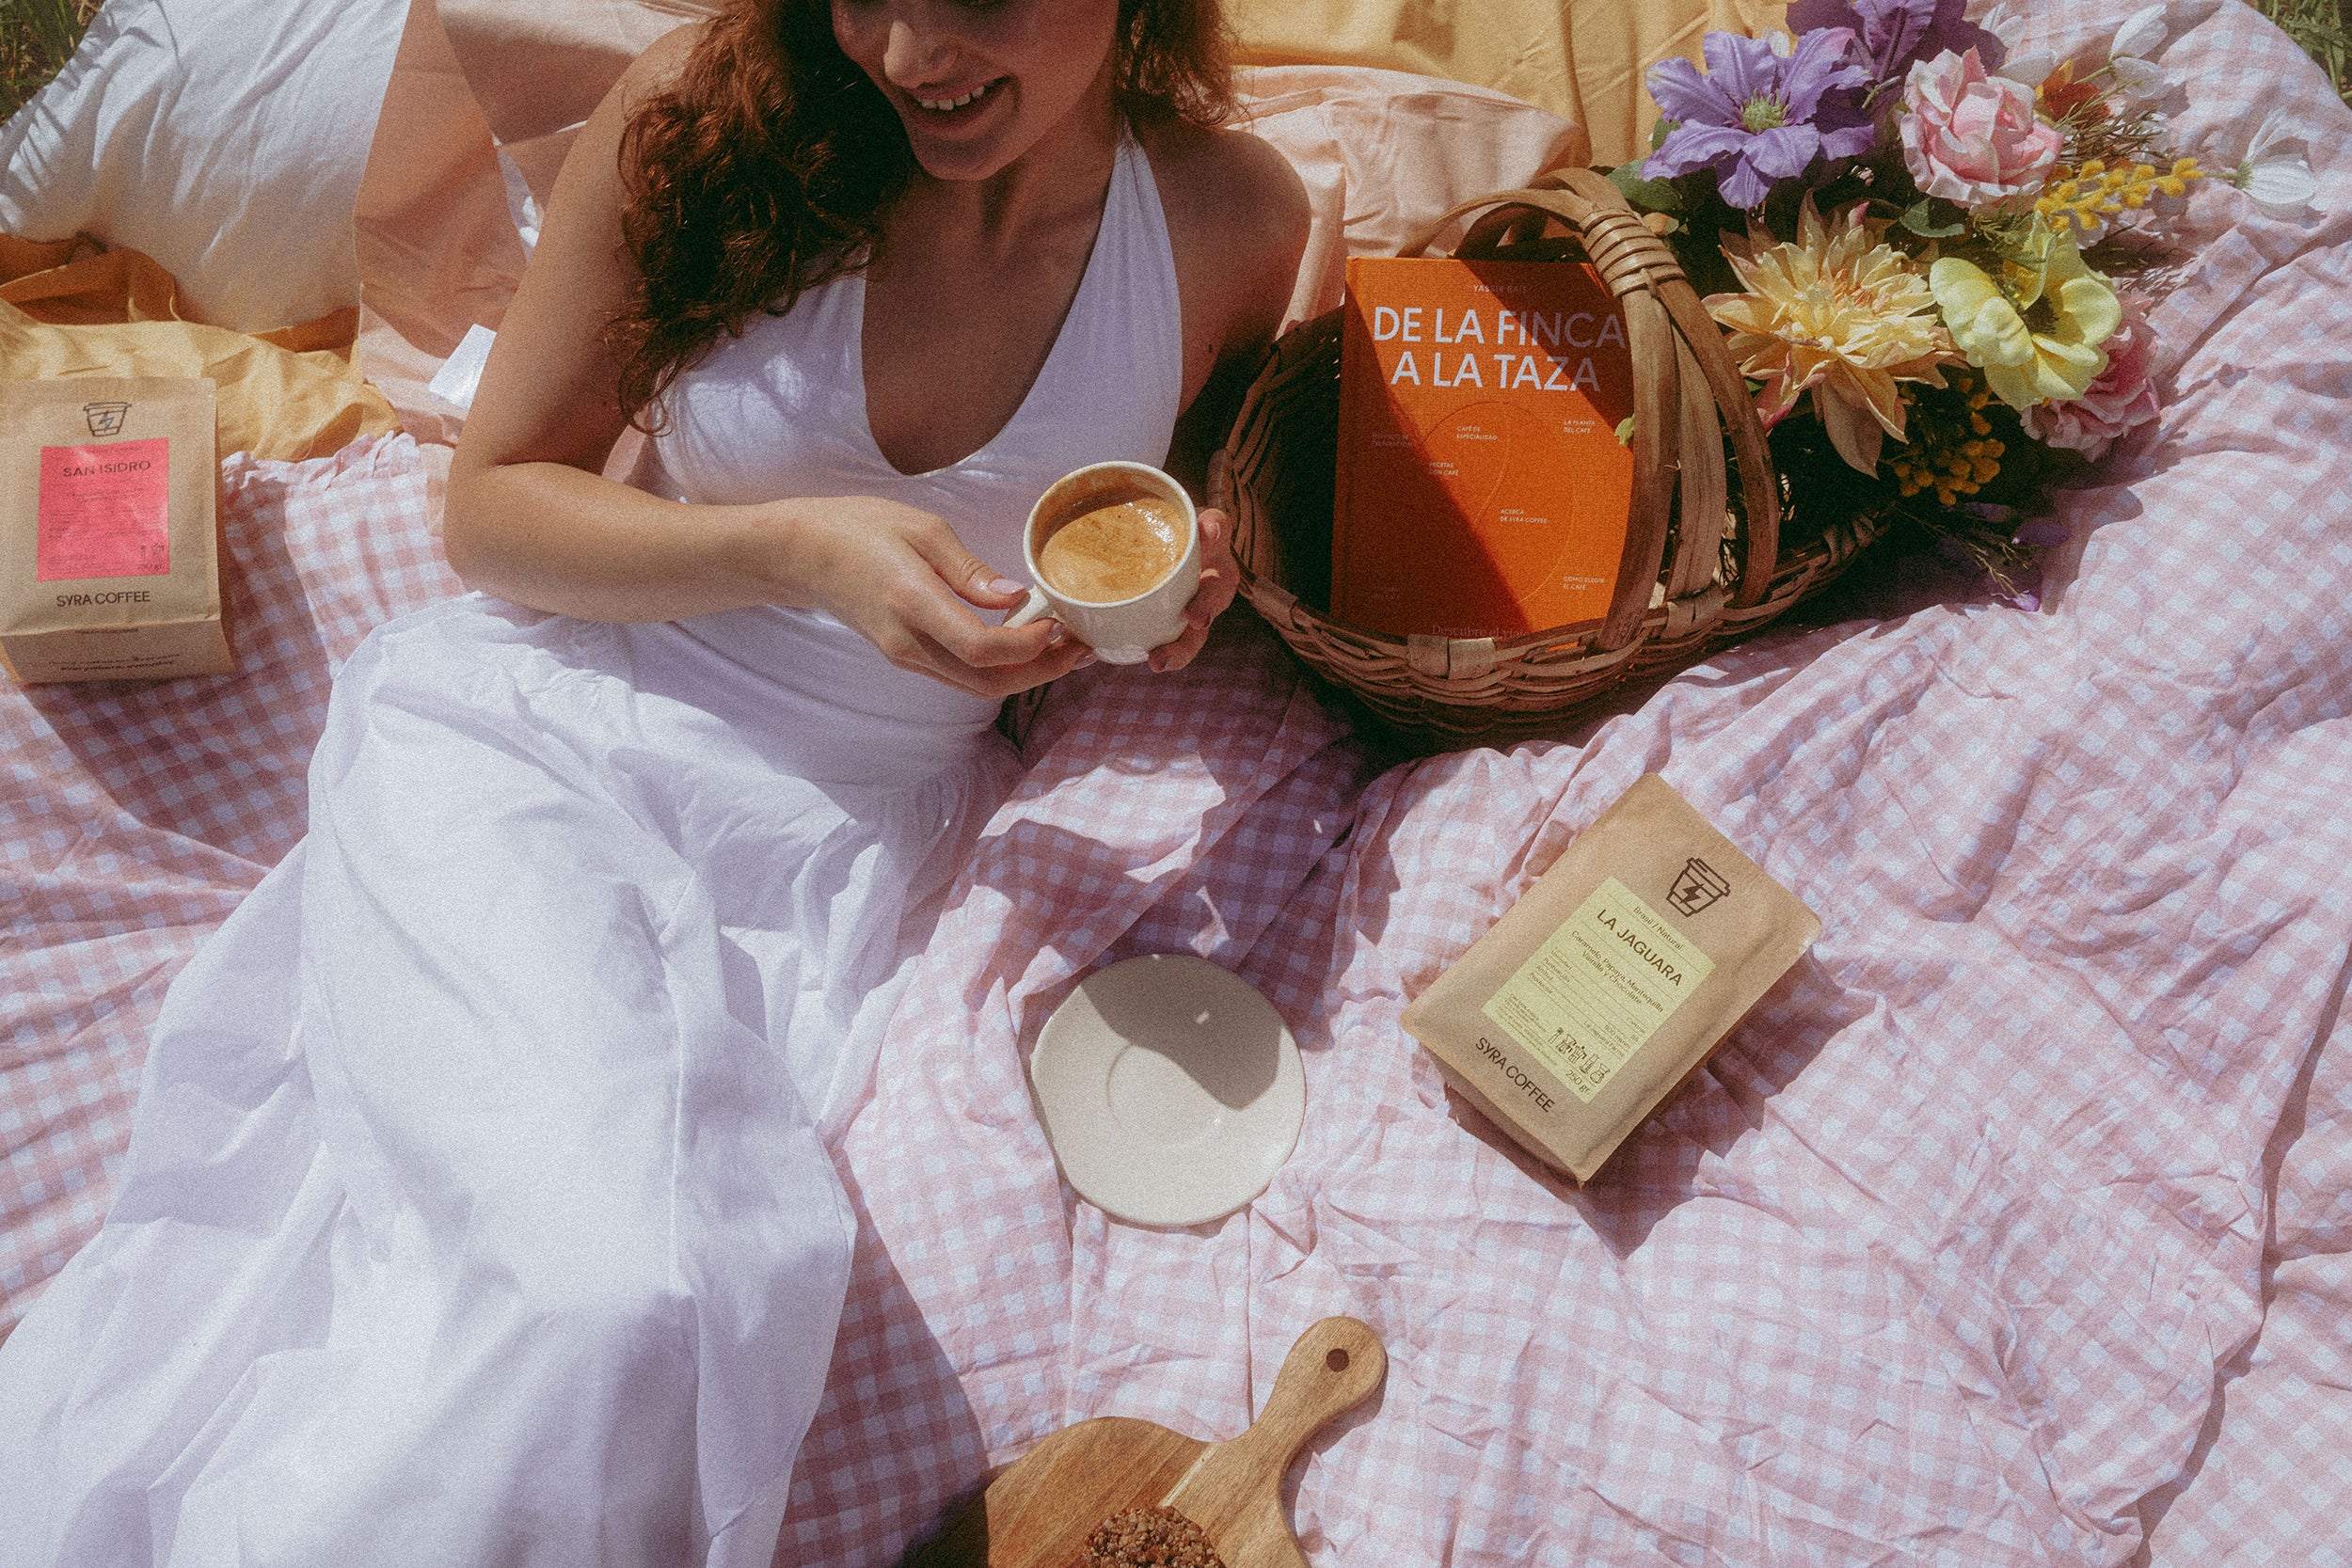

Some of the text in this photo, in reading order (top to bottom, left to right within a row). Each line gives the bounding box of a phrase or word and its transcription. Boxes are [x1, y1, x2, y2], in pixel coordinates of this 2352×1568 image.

[1374, 306, 1627, 349] DE LA FINCA
[1391, 351, 1600, 392] A LA TAZA
[63, 460, 151, 478] SAN ISIDRO
[56, 591, 151, 608] SYRA COFFEE
[1597, 910, 1681, 986] LA JAGUARA
[1633, 907, 1654, 925] Brasil
[1658, 927, 1683, 949] Natural
[1610, 974, 1641, 1004] Chocolate
[1476, 1037, 1506, 1069] SYRA
[1506, 1066, 1554, 1113] COFFEE
[1565, 1070, 1582, 1085] 250
